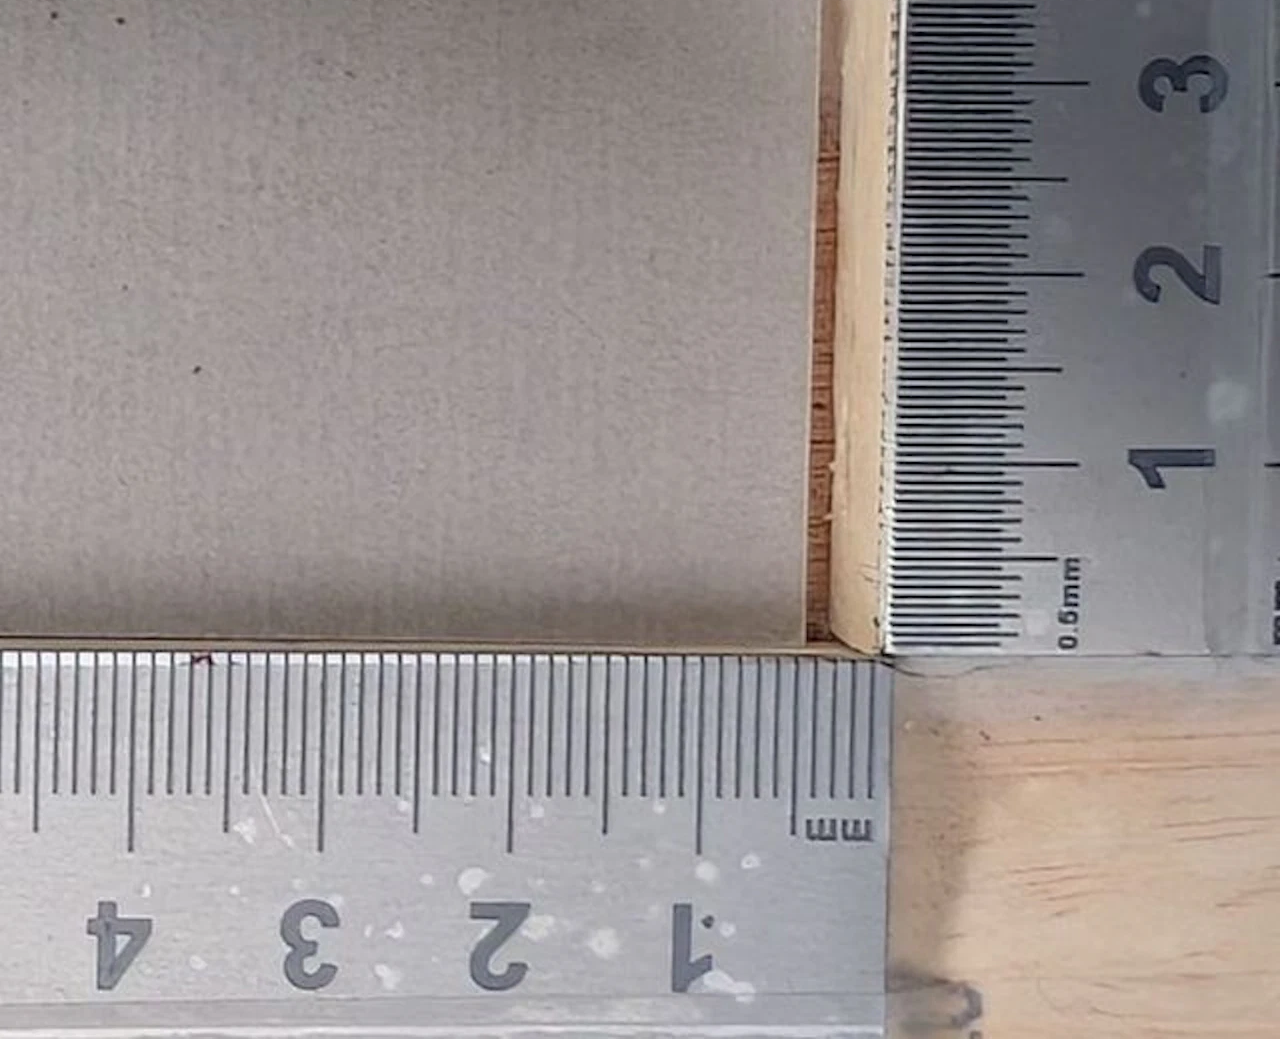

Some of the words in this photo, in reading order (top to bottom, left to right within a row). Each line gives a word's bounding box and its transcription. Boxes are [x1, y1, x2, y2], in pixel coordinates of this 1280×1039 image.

[1138, 54, 1228, 114] 3
[1133, 245, 1221, 305] 2
[1127, 448, 1216, 489] 1
[805, 818, 873, 841] mm
[87, 900, 152, 990] 4
[280, 899, 339, 990] 3
[469, 901, 531, 990] 2
[671, 903, 713, 991] 1
